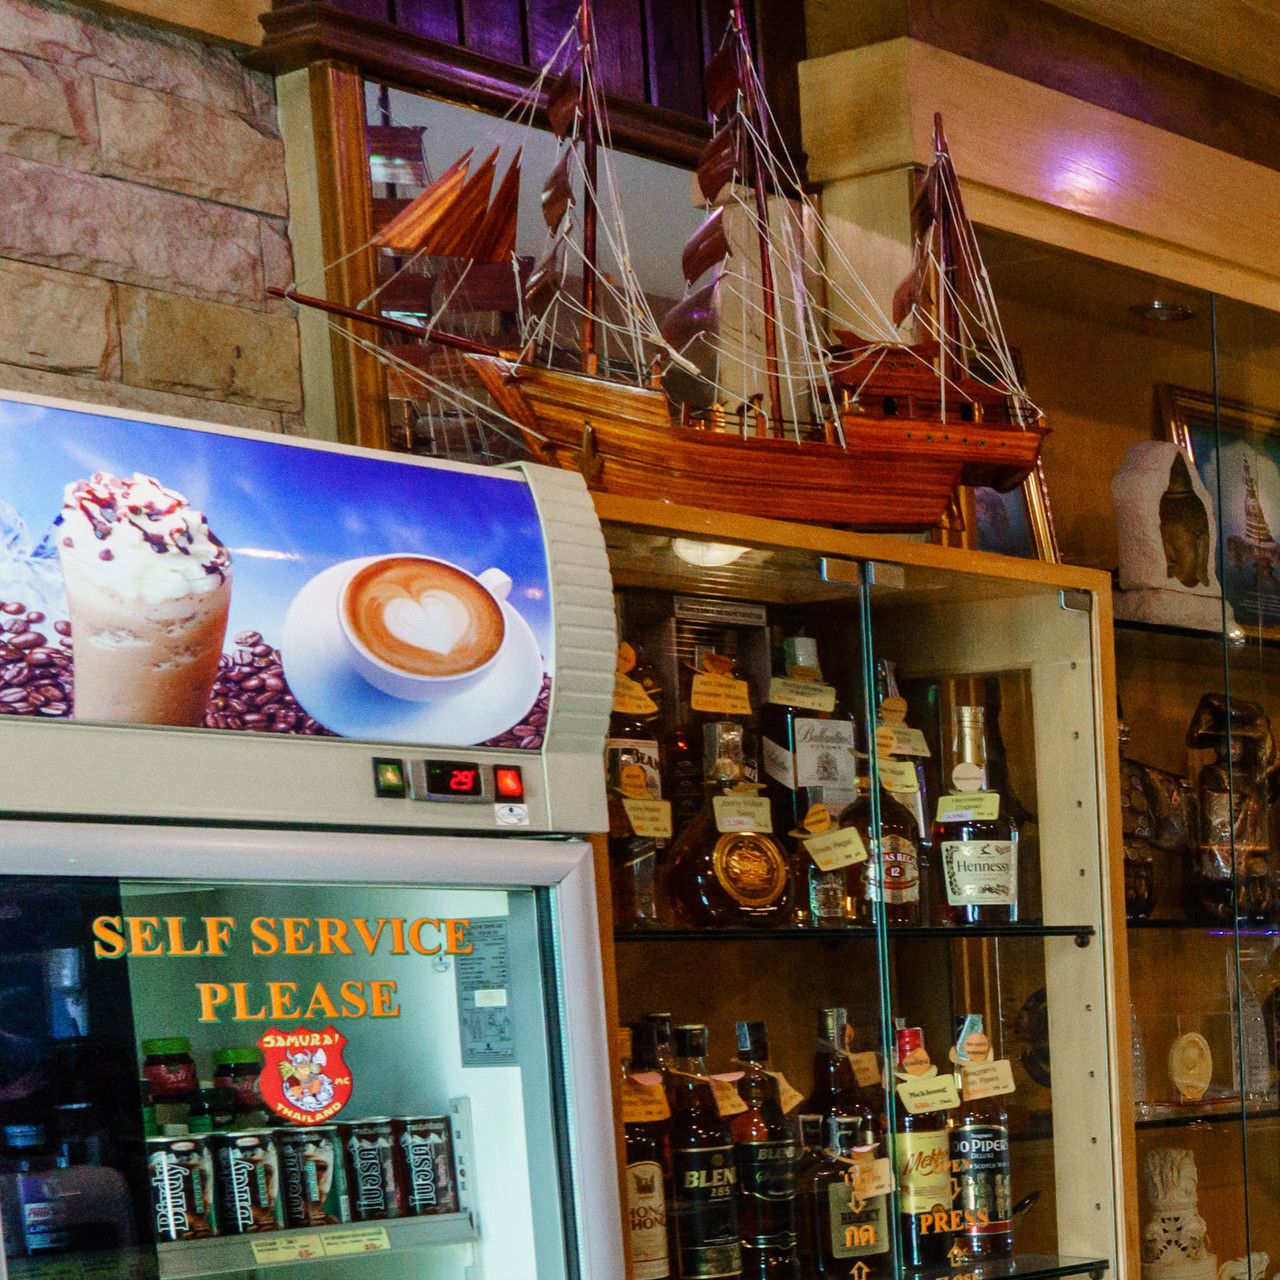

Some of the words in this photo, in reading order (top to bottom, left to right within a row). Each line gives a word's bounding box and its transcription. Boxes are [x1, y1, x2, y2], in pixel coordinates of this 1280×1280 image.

[956, 860, 1011, 875] Hennessy
[92, 915, 235, 958] SELF
[250, 917, 475, 956] SERVICE
[197, 980, 401, 1022] PLEASE
[263, 1033, 340, 1048] SAMURAI
[275, 1101, 343, 1124] THAILAND
[920, 1207, 990, 1235] PRESS
[845, 1224, 876, 1248] กด
